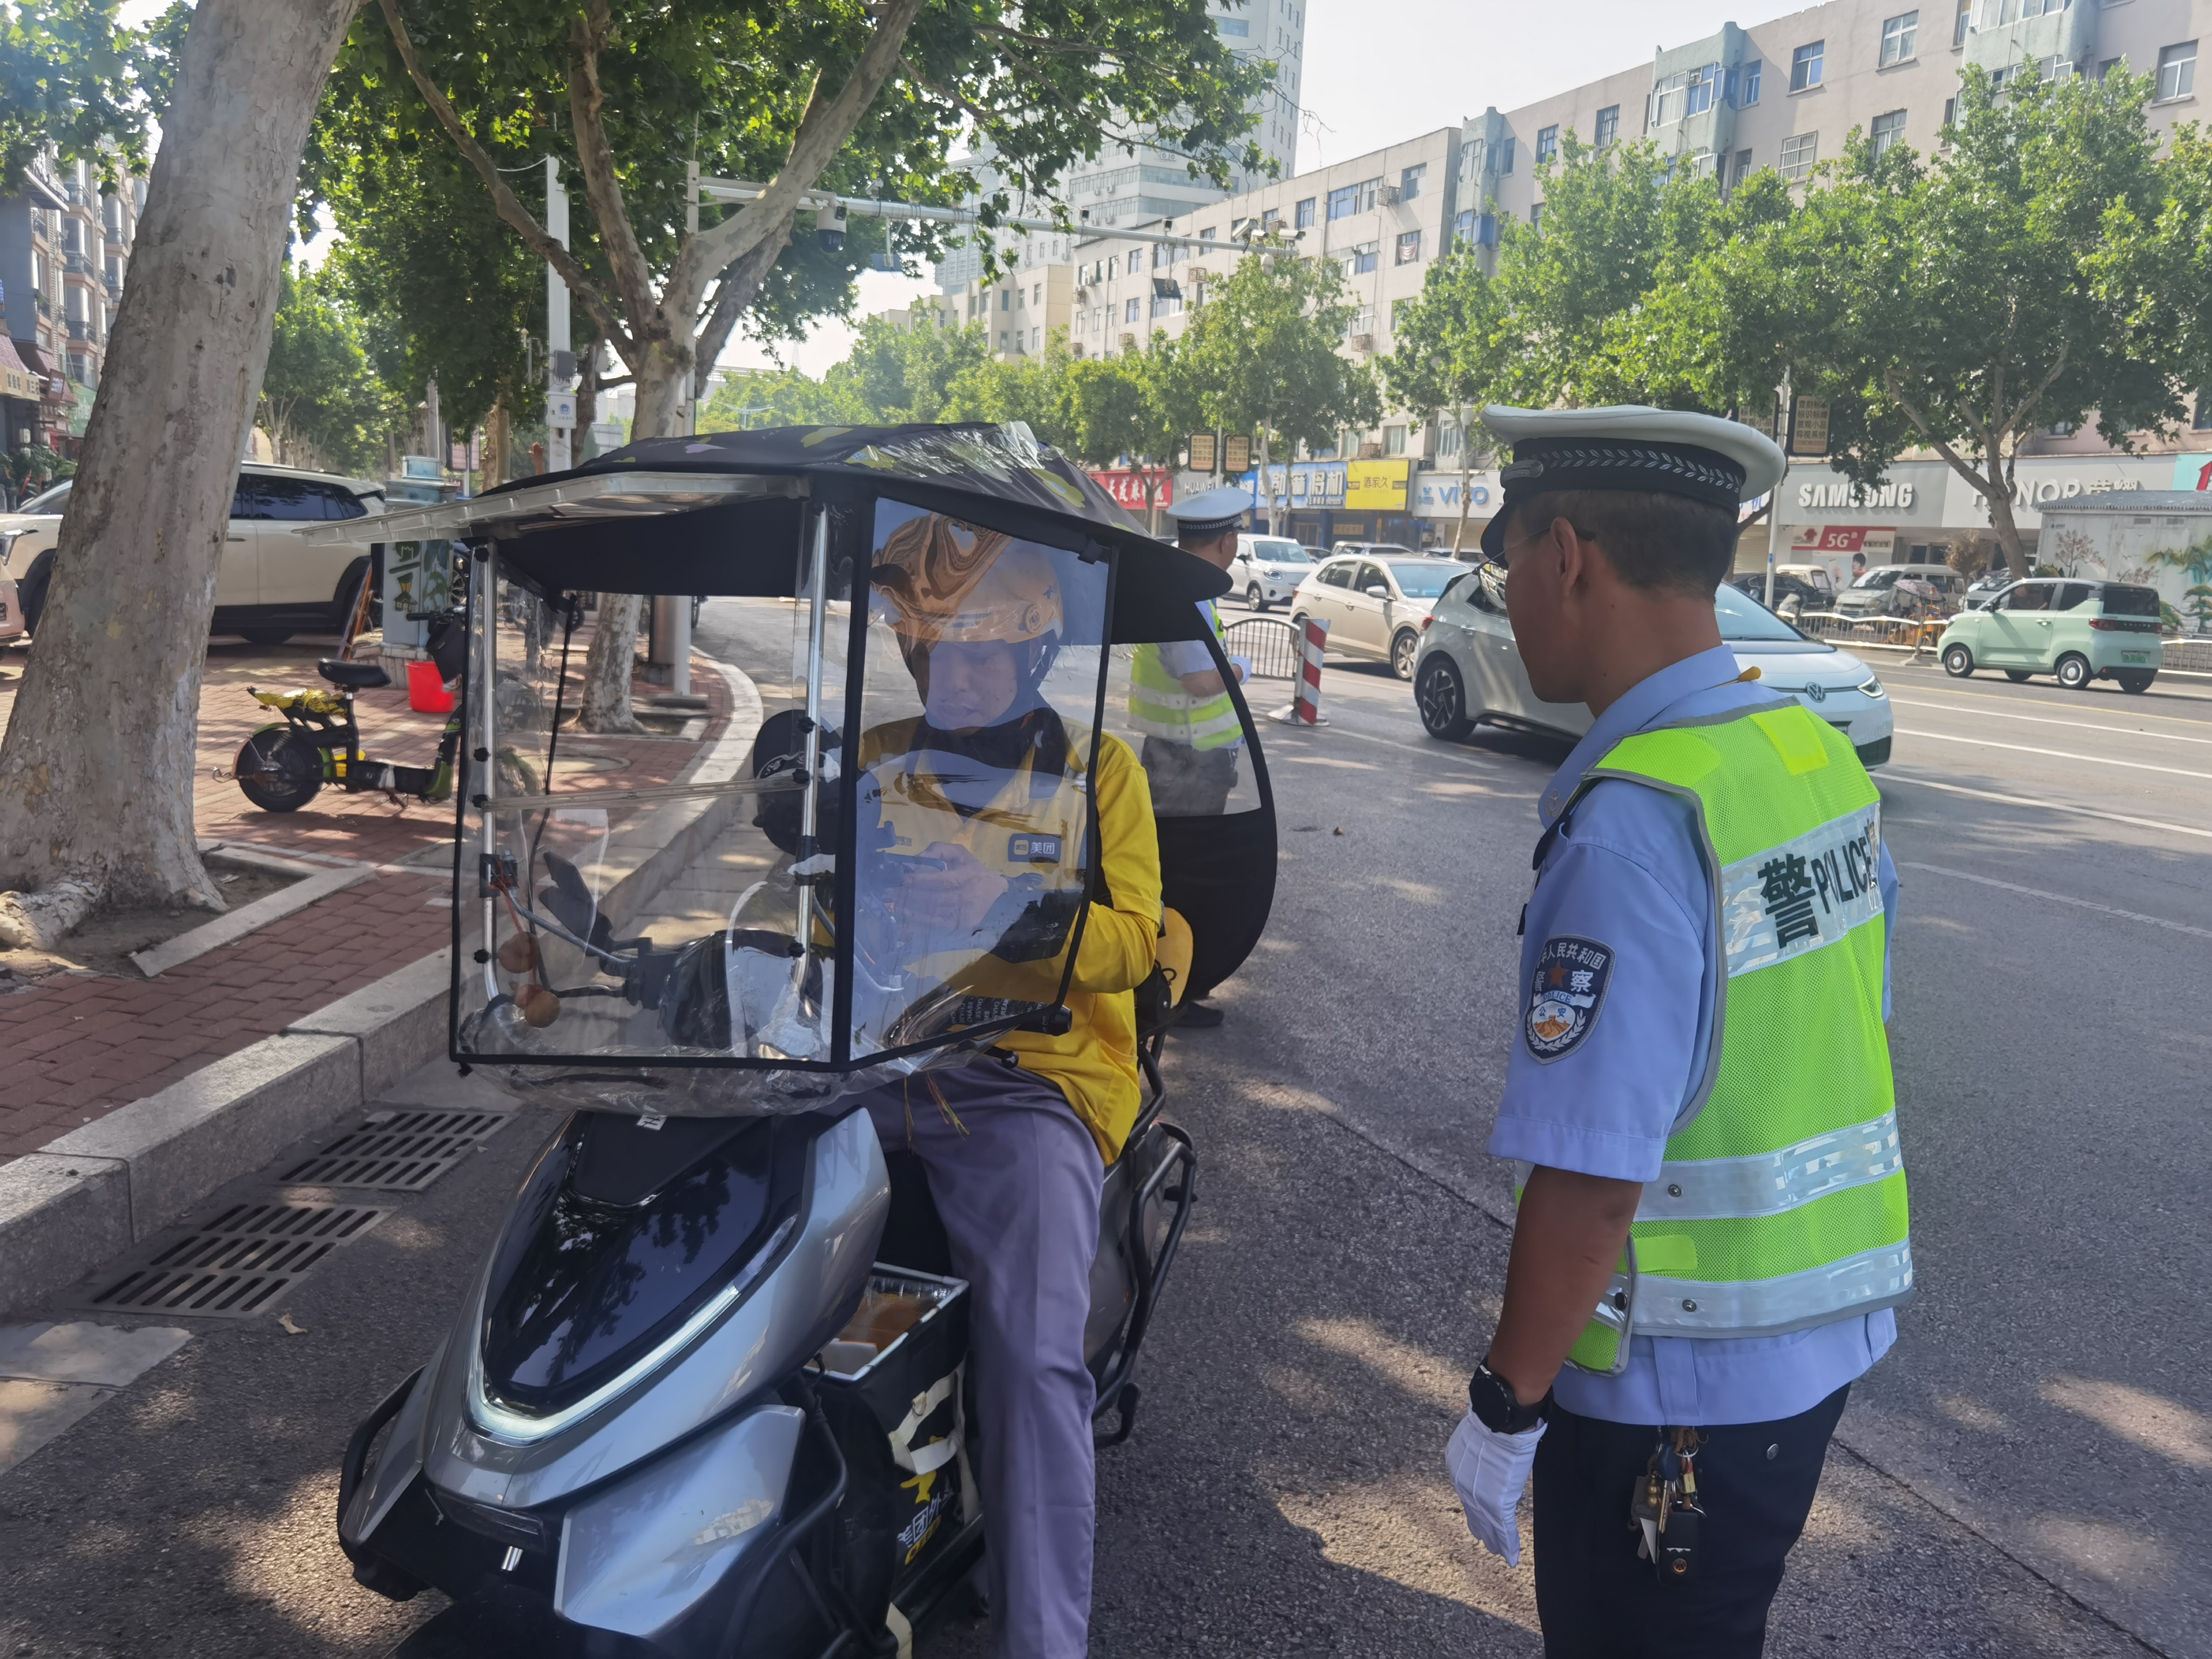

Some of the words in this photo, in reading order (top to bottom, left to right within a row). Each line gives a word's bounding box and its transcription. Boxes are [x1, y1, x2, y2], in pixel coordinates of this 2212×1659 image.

[1972, 478, 2081, 507] HNOR
[1030, 841, 1055, 854] 美团
[1757, 853, 1819, 949] 警
[1536, 942, 1607, 970] 华人民共和国
[1543, 990, 1572, 1003] POLICE
